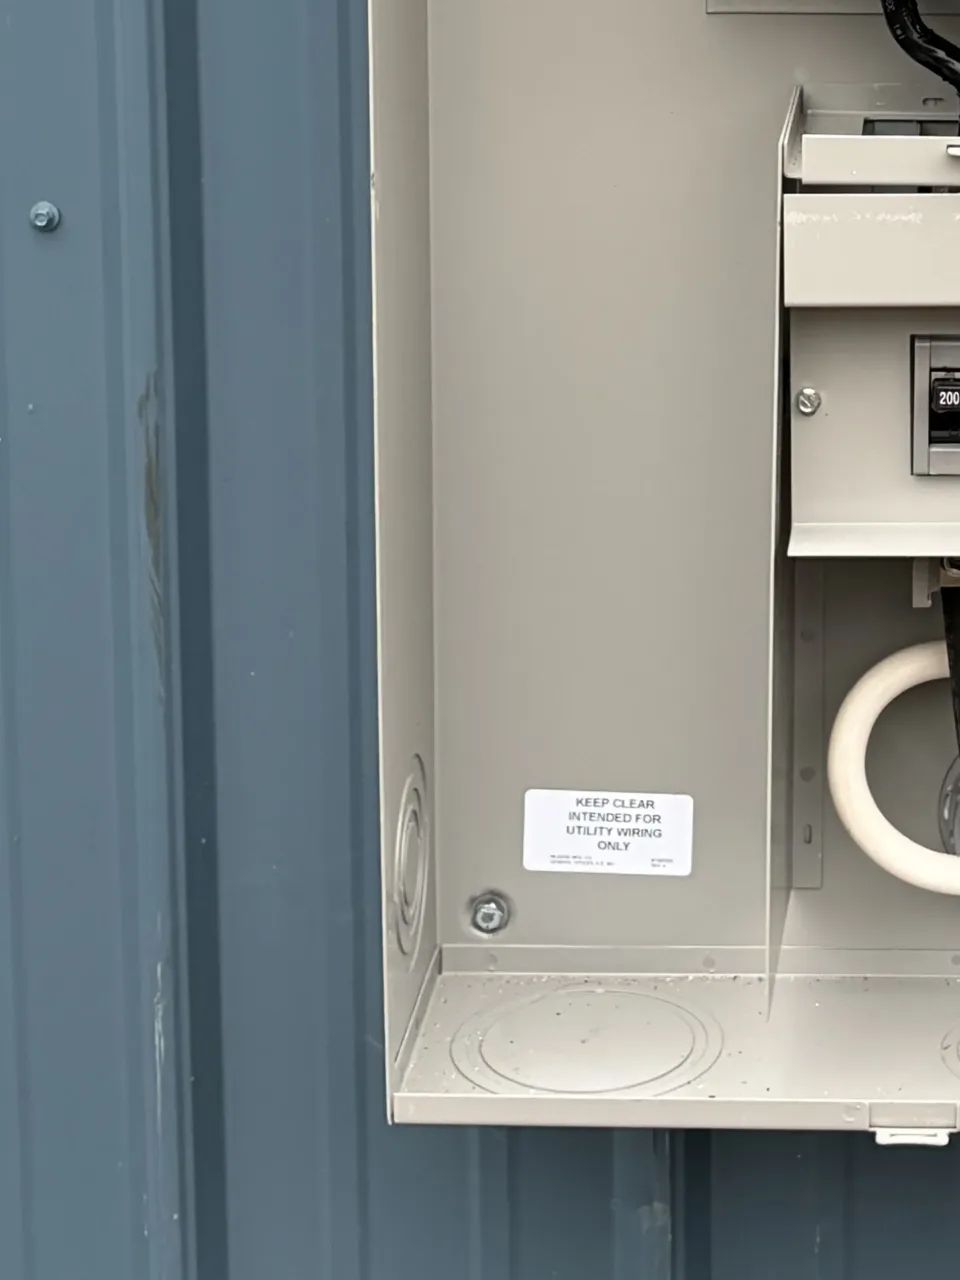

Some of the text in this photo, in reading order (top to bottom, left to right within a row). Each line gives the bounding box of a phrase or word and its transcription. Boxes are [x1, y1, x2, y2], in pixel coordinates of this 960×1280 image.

[939, 391, 960, 406] 200
[575, 797, 656, 810] KEEP CLEAR
[568, 811, 662, 824] INTENDED FOR
[566, 825, 663, 838] UTILITY WIRING
[597, 840, 631, 851] ONLY
